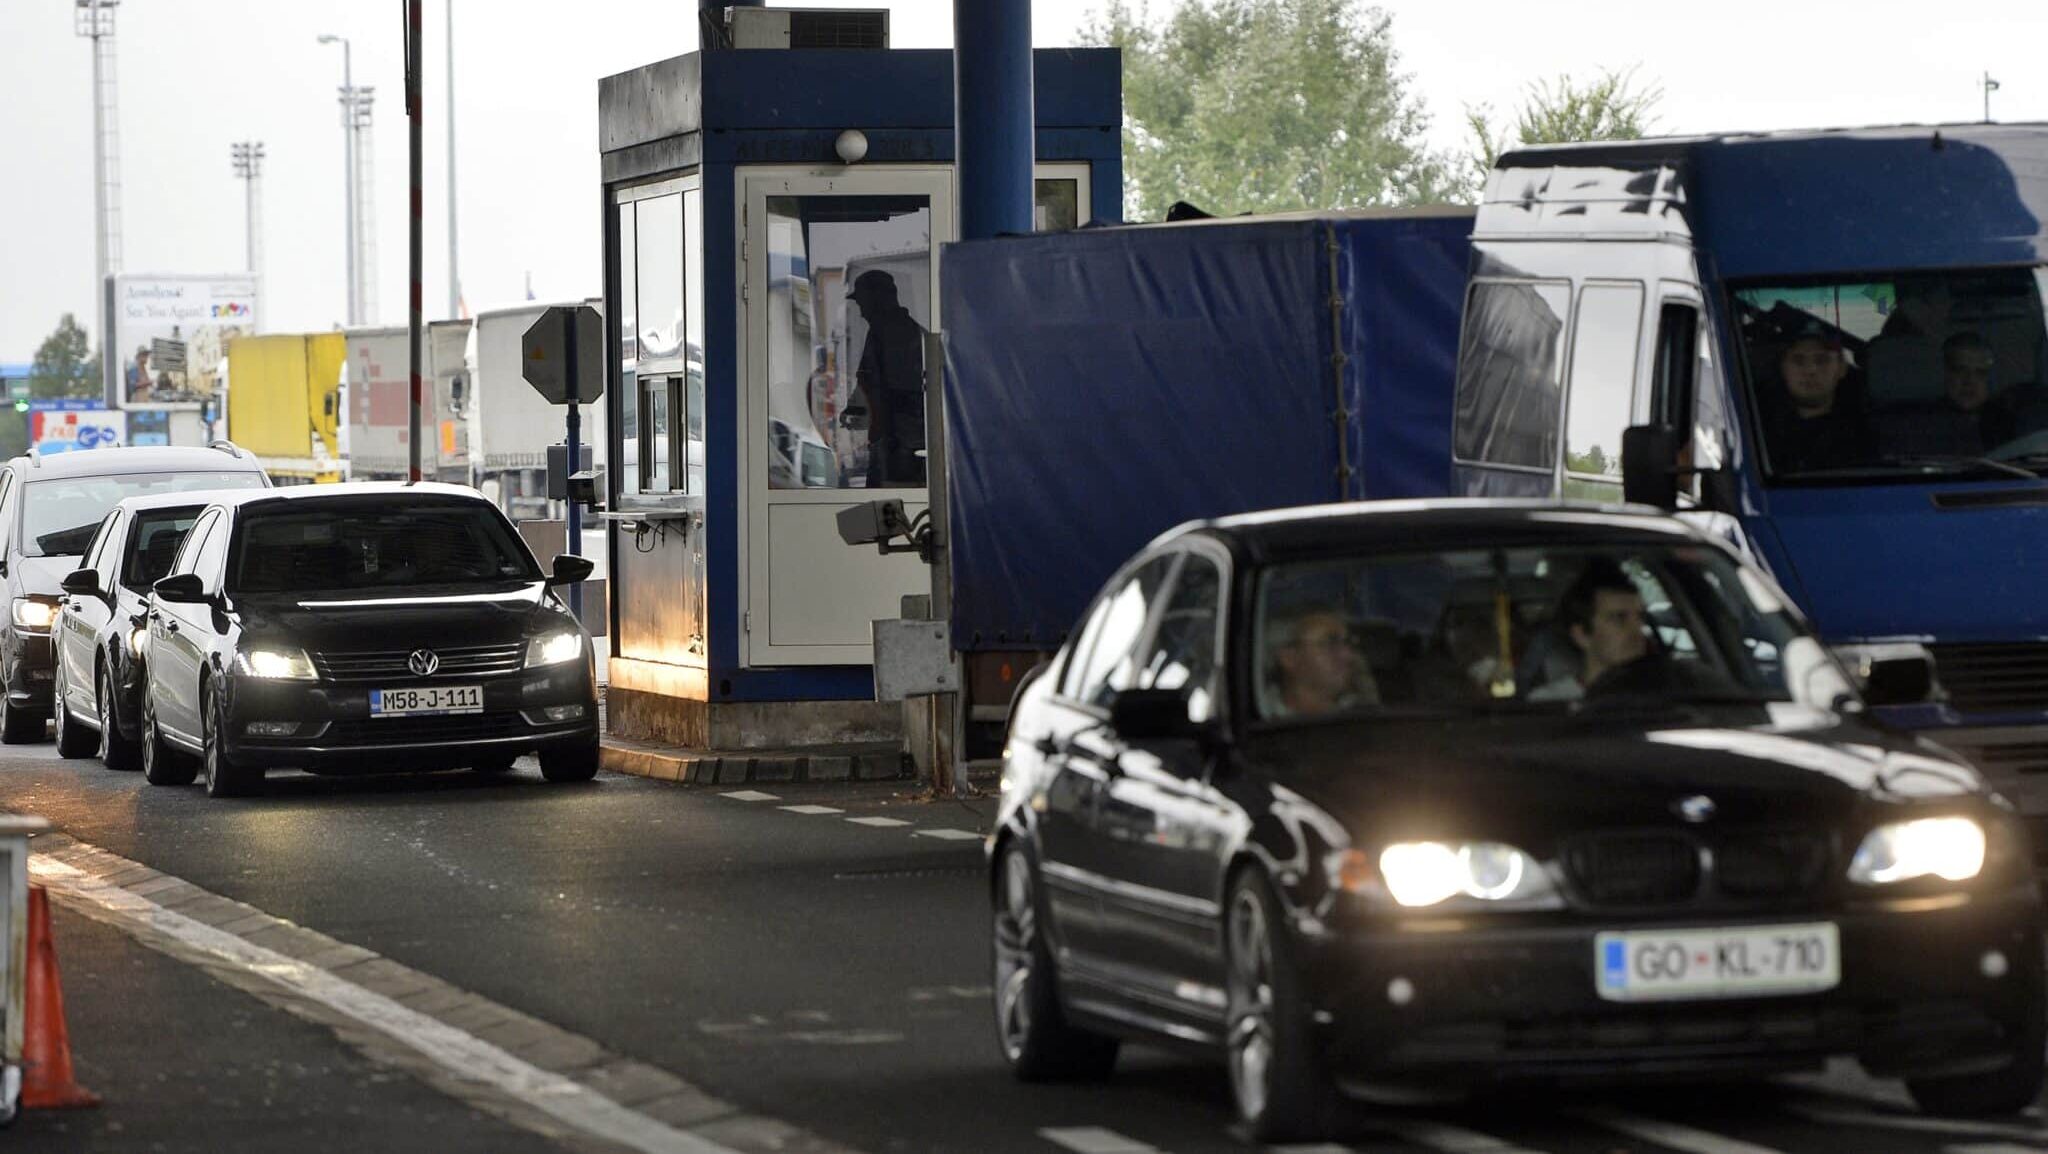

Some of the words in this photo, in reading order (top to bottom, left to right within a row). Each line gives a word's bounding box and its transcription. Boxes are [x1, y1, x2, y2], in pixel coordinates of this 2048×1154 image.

[127, 304, 143, 318] See
[145, 304, 165, 318] You
[167, 304, 204, 321] Again!
[383, 688, 480, 709] M58-J-111
[1635, 941, 1687, 980] GO
